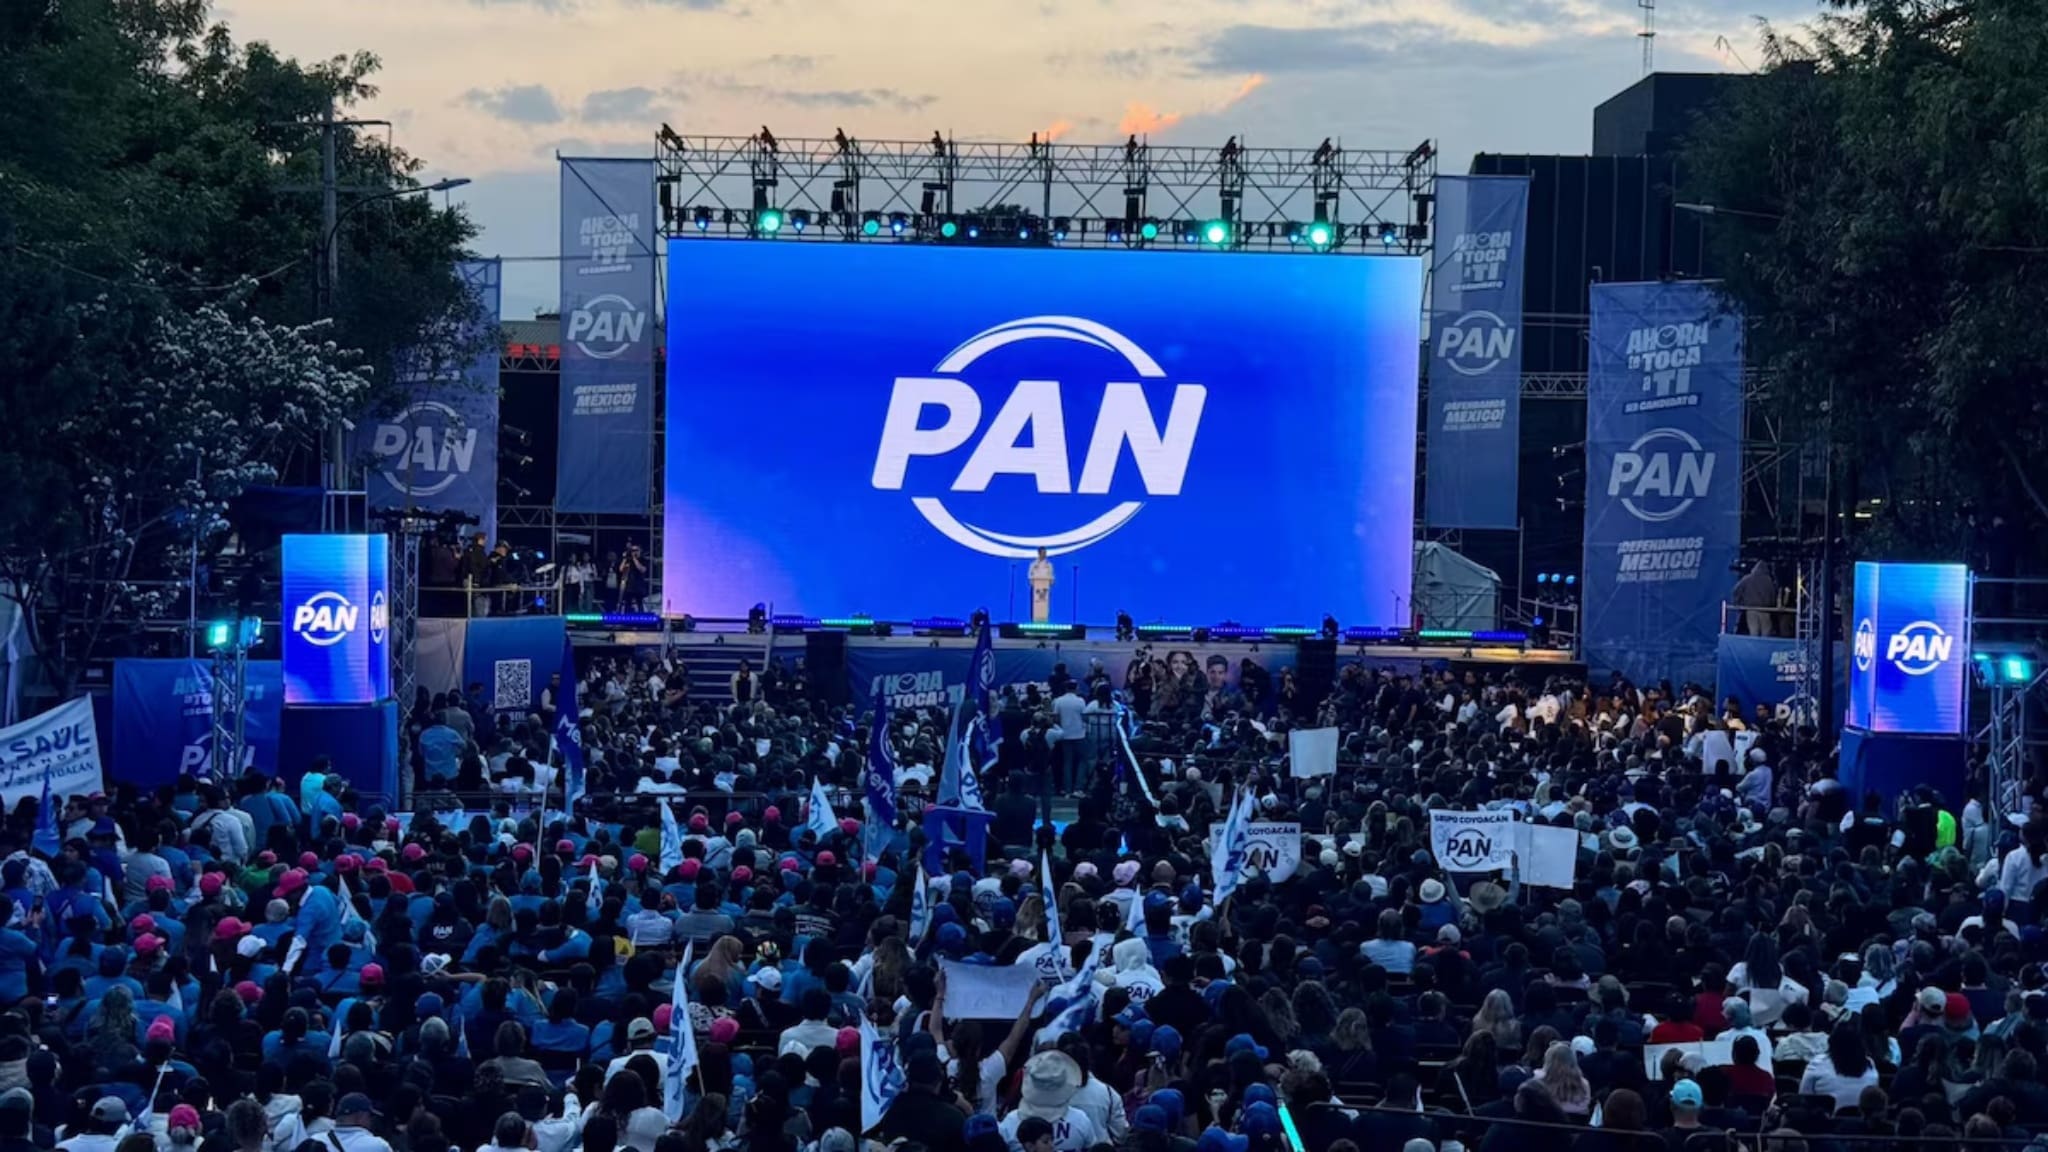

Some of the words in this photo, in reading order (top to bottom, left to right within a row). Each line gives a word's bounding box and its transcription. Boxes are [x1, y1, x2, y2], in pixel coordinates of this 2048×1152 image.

[1464, 248, 1507, 264] TOCA
[1472, 262, 1500, 282] TI
[567, 309, 646, 342] PAN
[1626, 320, 1709, 355] AHORA
[1437, 326, 1516, 359] PAN
[1642, 345, 1701, 373] TOCA
[1653, 367, 1691, 397] TI
[373, 424, 478, 473] PAN
[872, 376, 1208, 496] PAN
[1607, 452, 1717, 498] PAN
[292, 604, 360, 632] PAN
[1855, 631, 1874, 658] PAN
[1886, 633, 1953, 661] PAN
[9, 724, 91, 760] SAÚL
[1446, 837, 1492, 858] PAN
